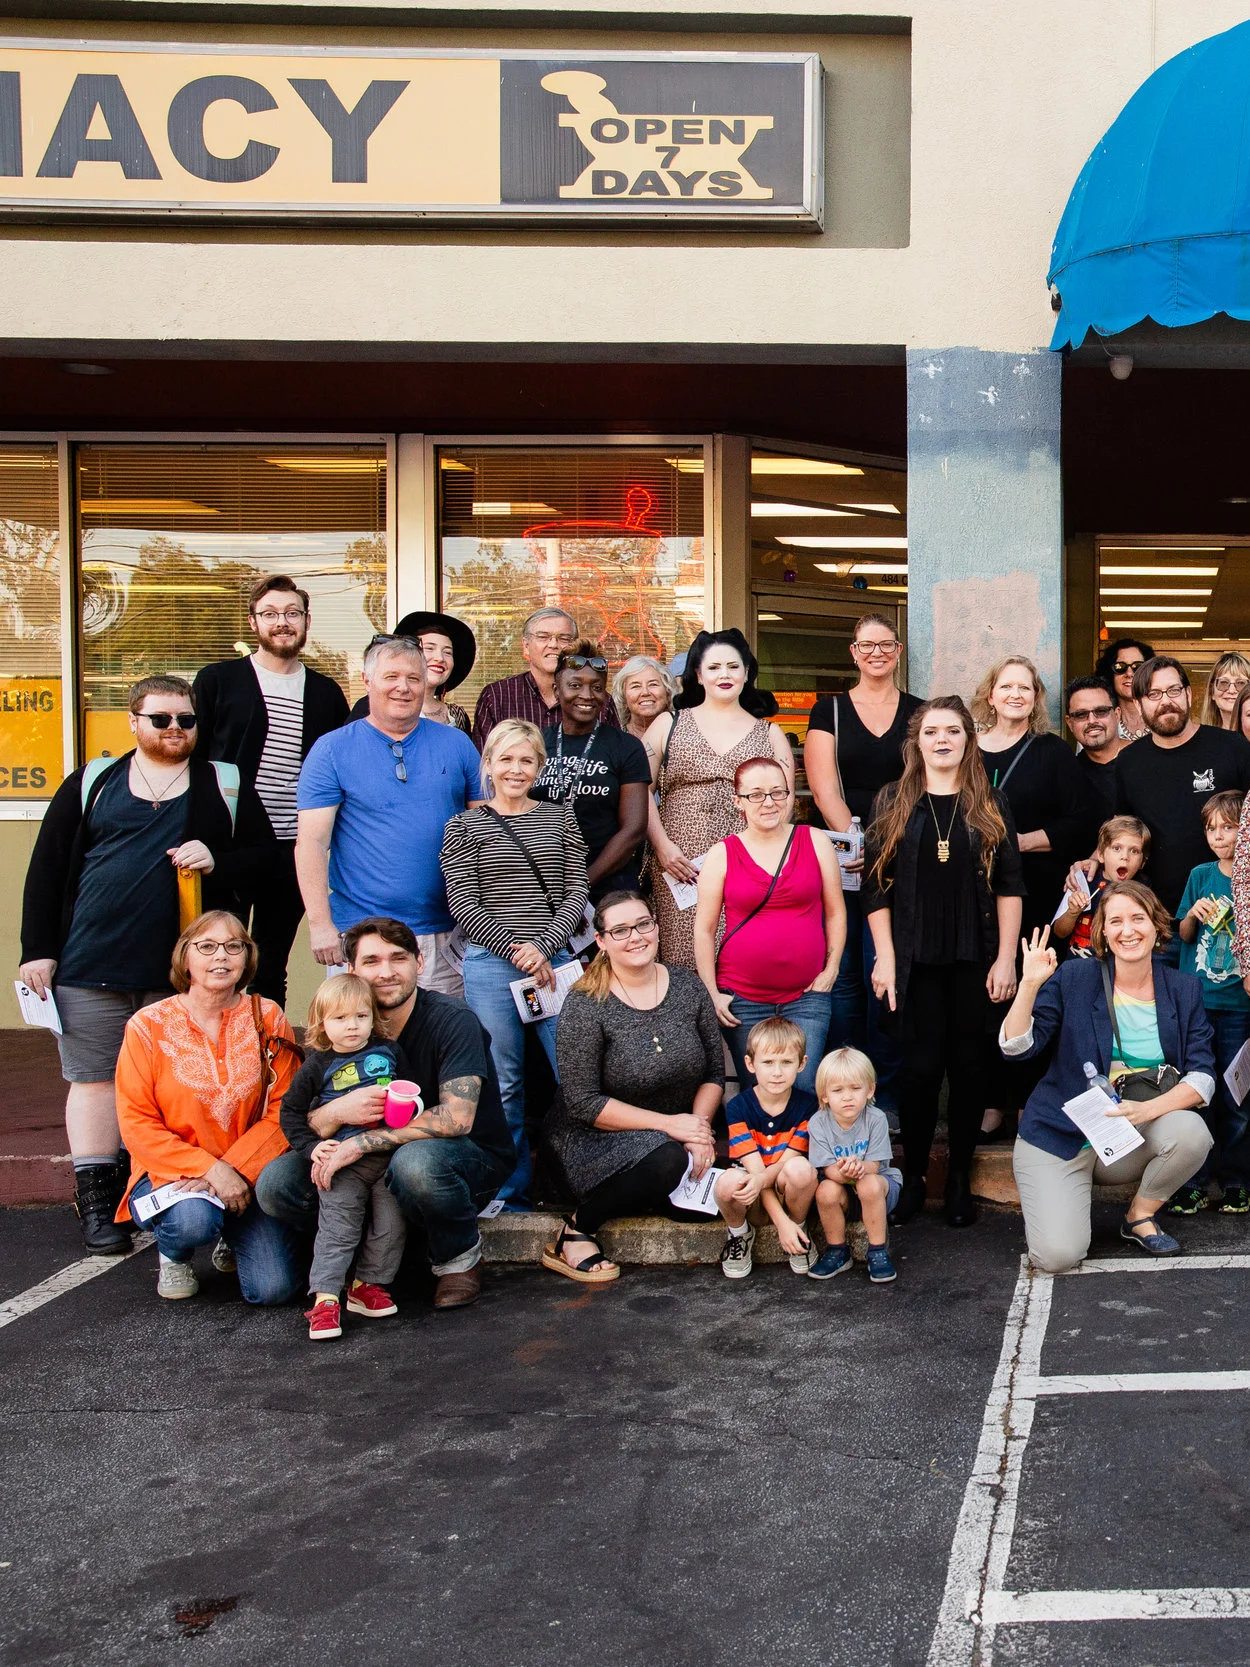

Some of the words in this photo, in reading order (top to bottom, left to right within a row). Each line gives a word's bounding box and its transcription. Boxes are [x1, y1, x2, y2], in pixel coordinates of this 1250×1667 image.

[0, 70, 411, 184] ACY
[590, 117, 746, 146] OPEN
[654, 146, 680, 170] 7
[590, 169, 745, 197] DAYS
[577, 781, 610, 796] love
